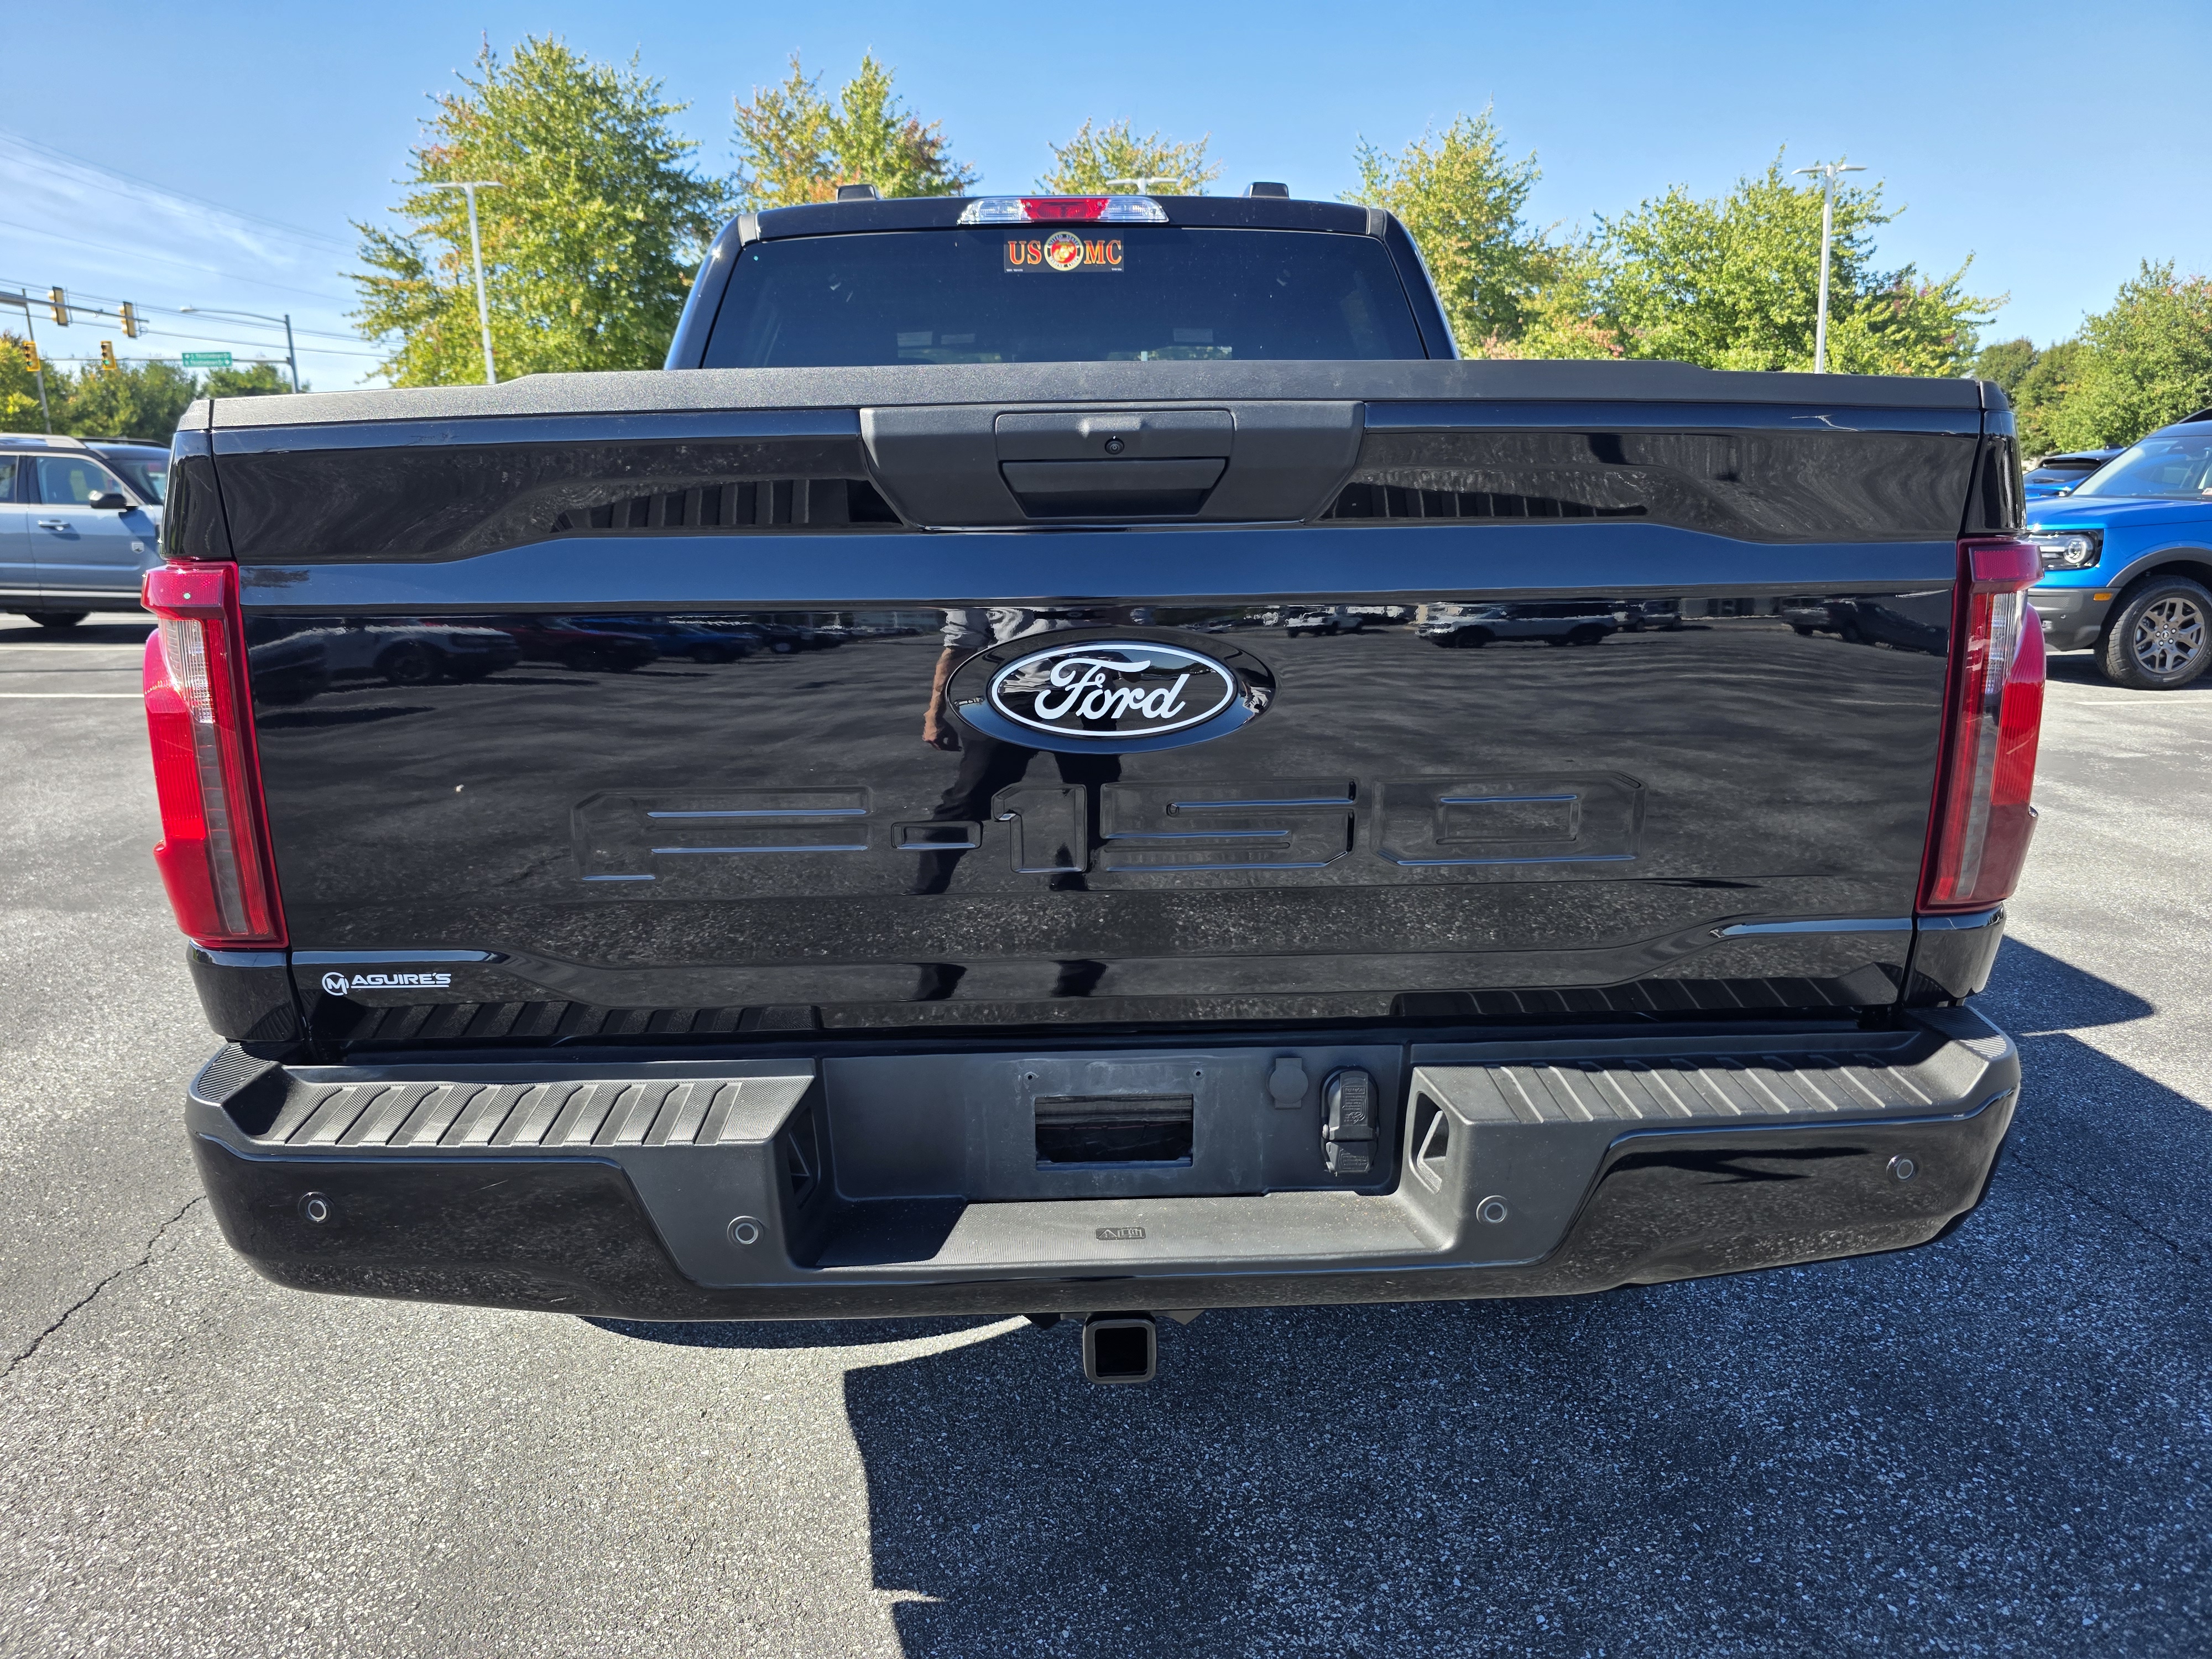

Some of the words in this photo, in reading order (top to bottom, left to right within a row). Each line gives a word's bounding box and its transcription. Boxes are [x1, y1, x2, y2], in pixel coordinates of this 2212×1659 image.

[1008, 240, 1042, 264] US
[1084, 239, 1122, 264] MC
[1035, 658, 1190, 719] Ford
[568, 771, 1646, 881] F-150
